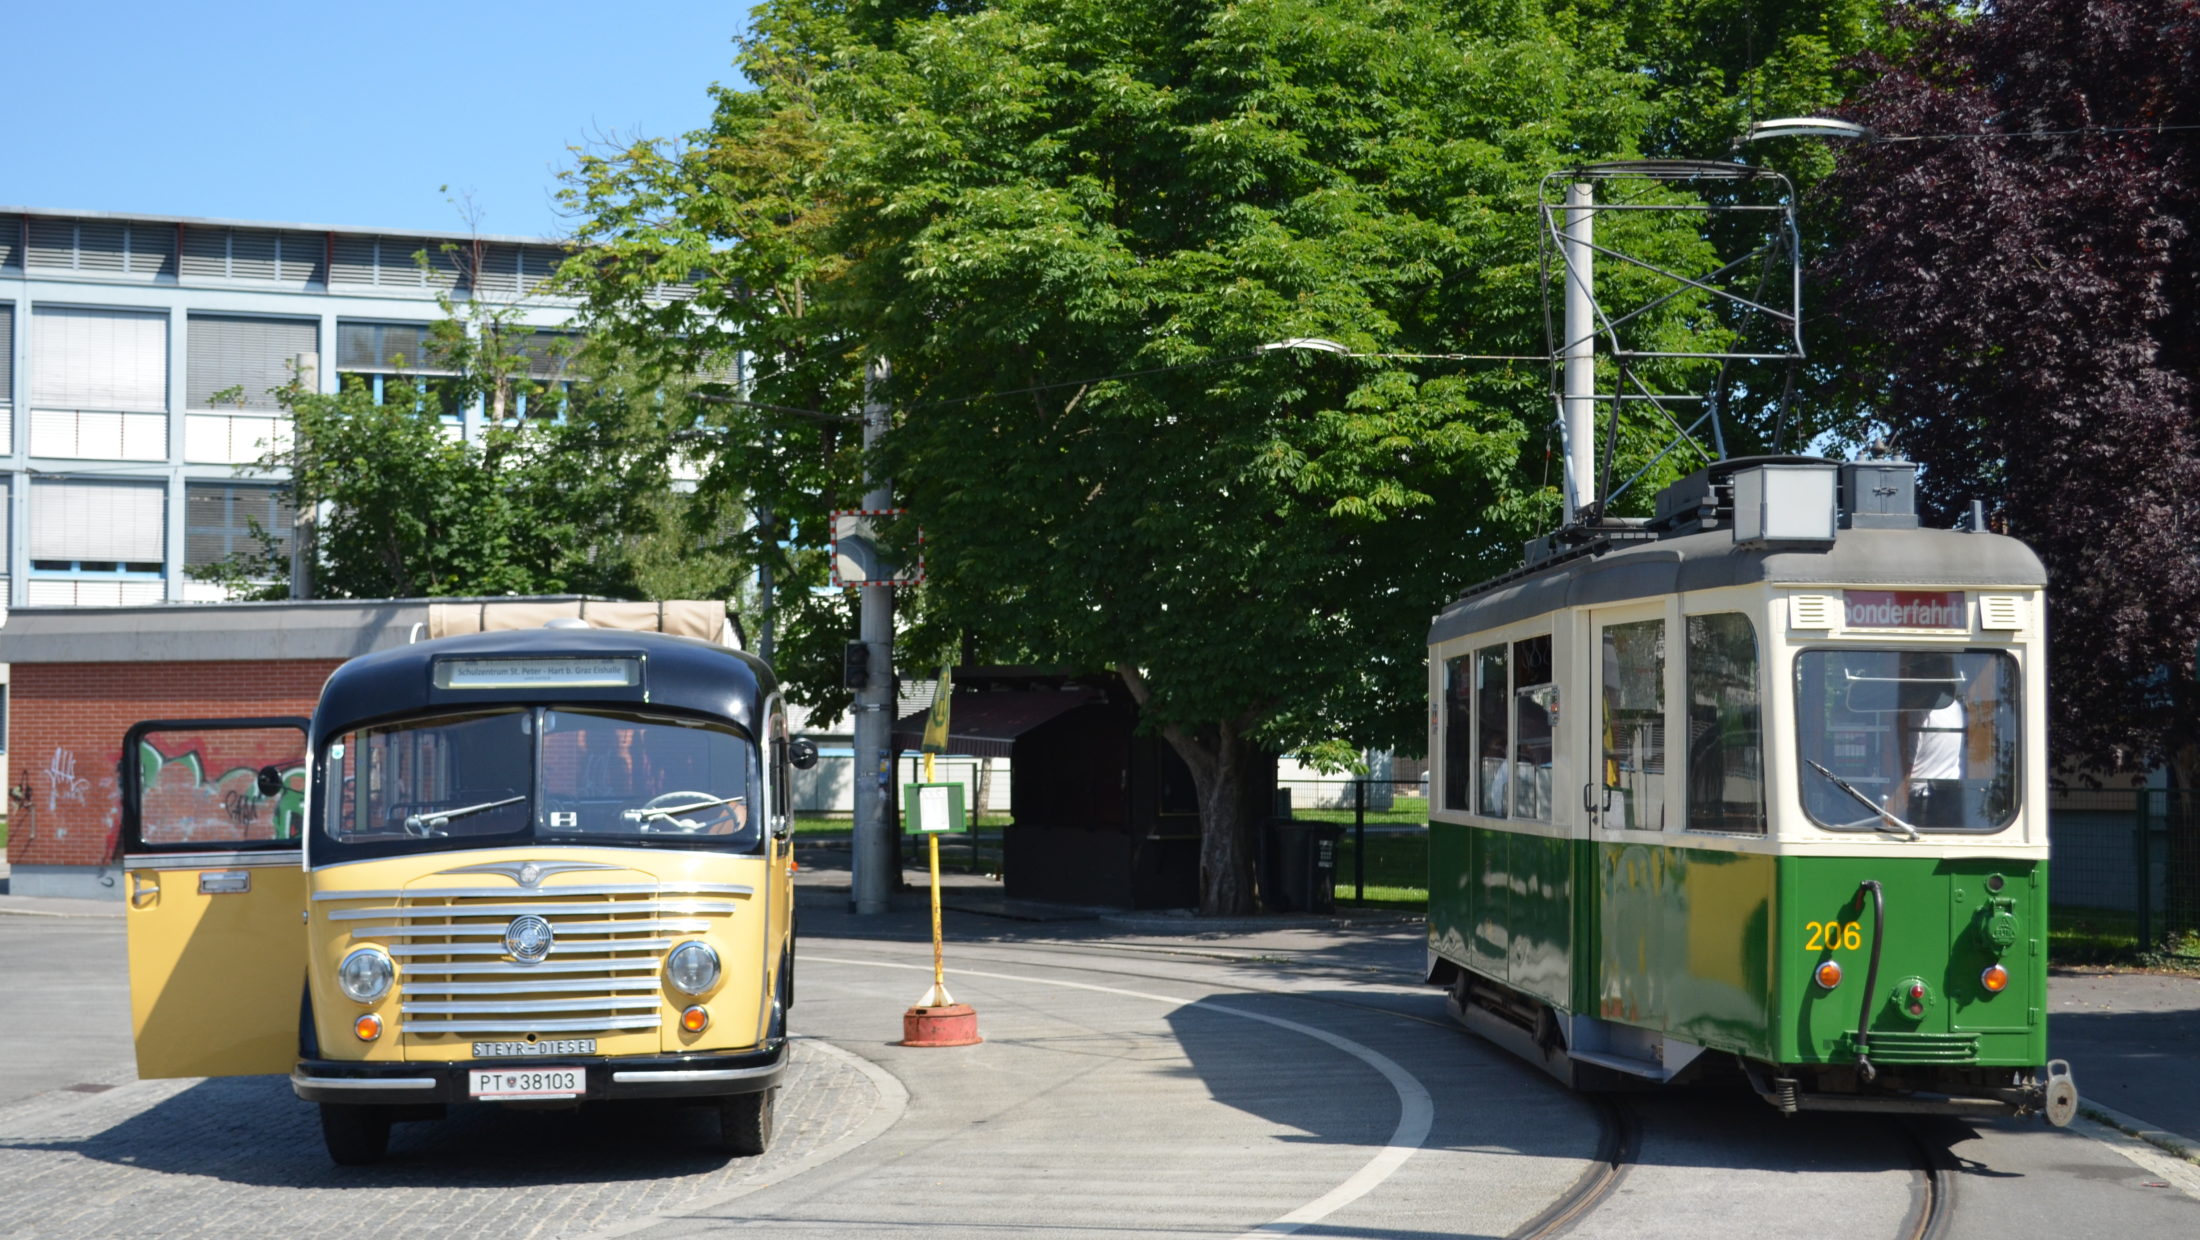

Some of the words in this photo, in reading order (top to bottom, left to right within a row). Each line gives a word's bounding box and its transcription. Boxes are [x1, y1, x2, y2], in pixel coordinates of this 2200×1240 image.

[457, 667, 509, 677] Schulzentrum
[510, 666, 521, 676] St.
[521, 666, 542, 676] Peter
[548, 665, 565, 675] Hart
[1805, 921, 1862, 951] 206
[474, 1040, 596, 1056] STEYR-DIESEL
[480, 1074, 502, 1091] PT
[520, 1072, 575, 1090] 38103
